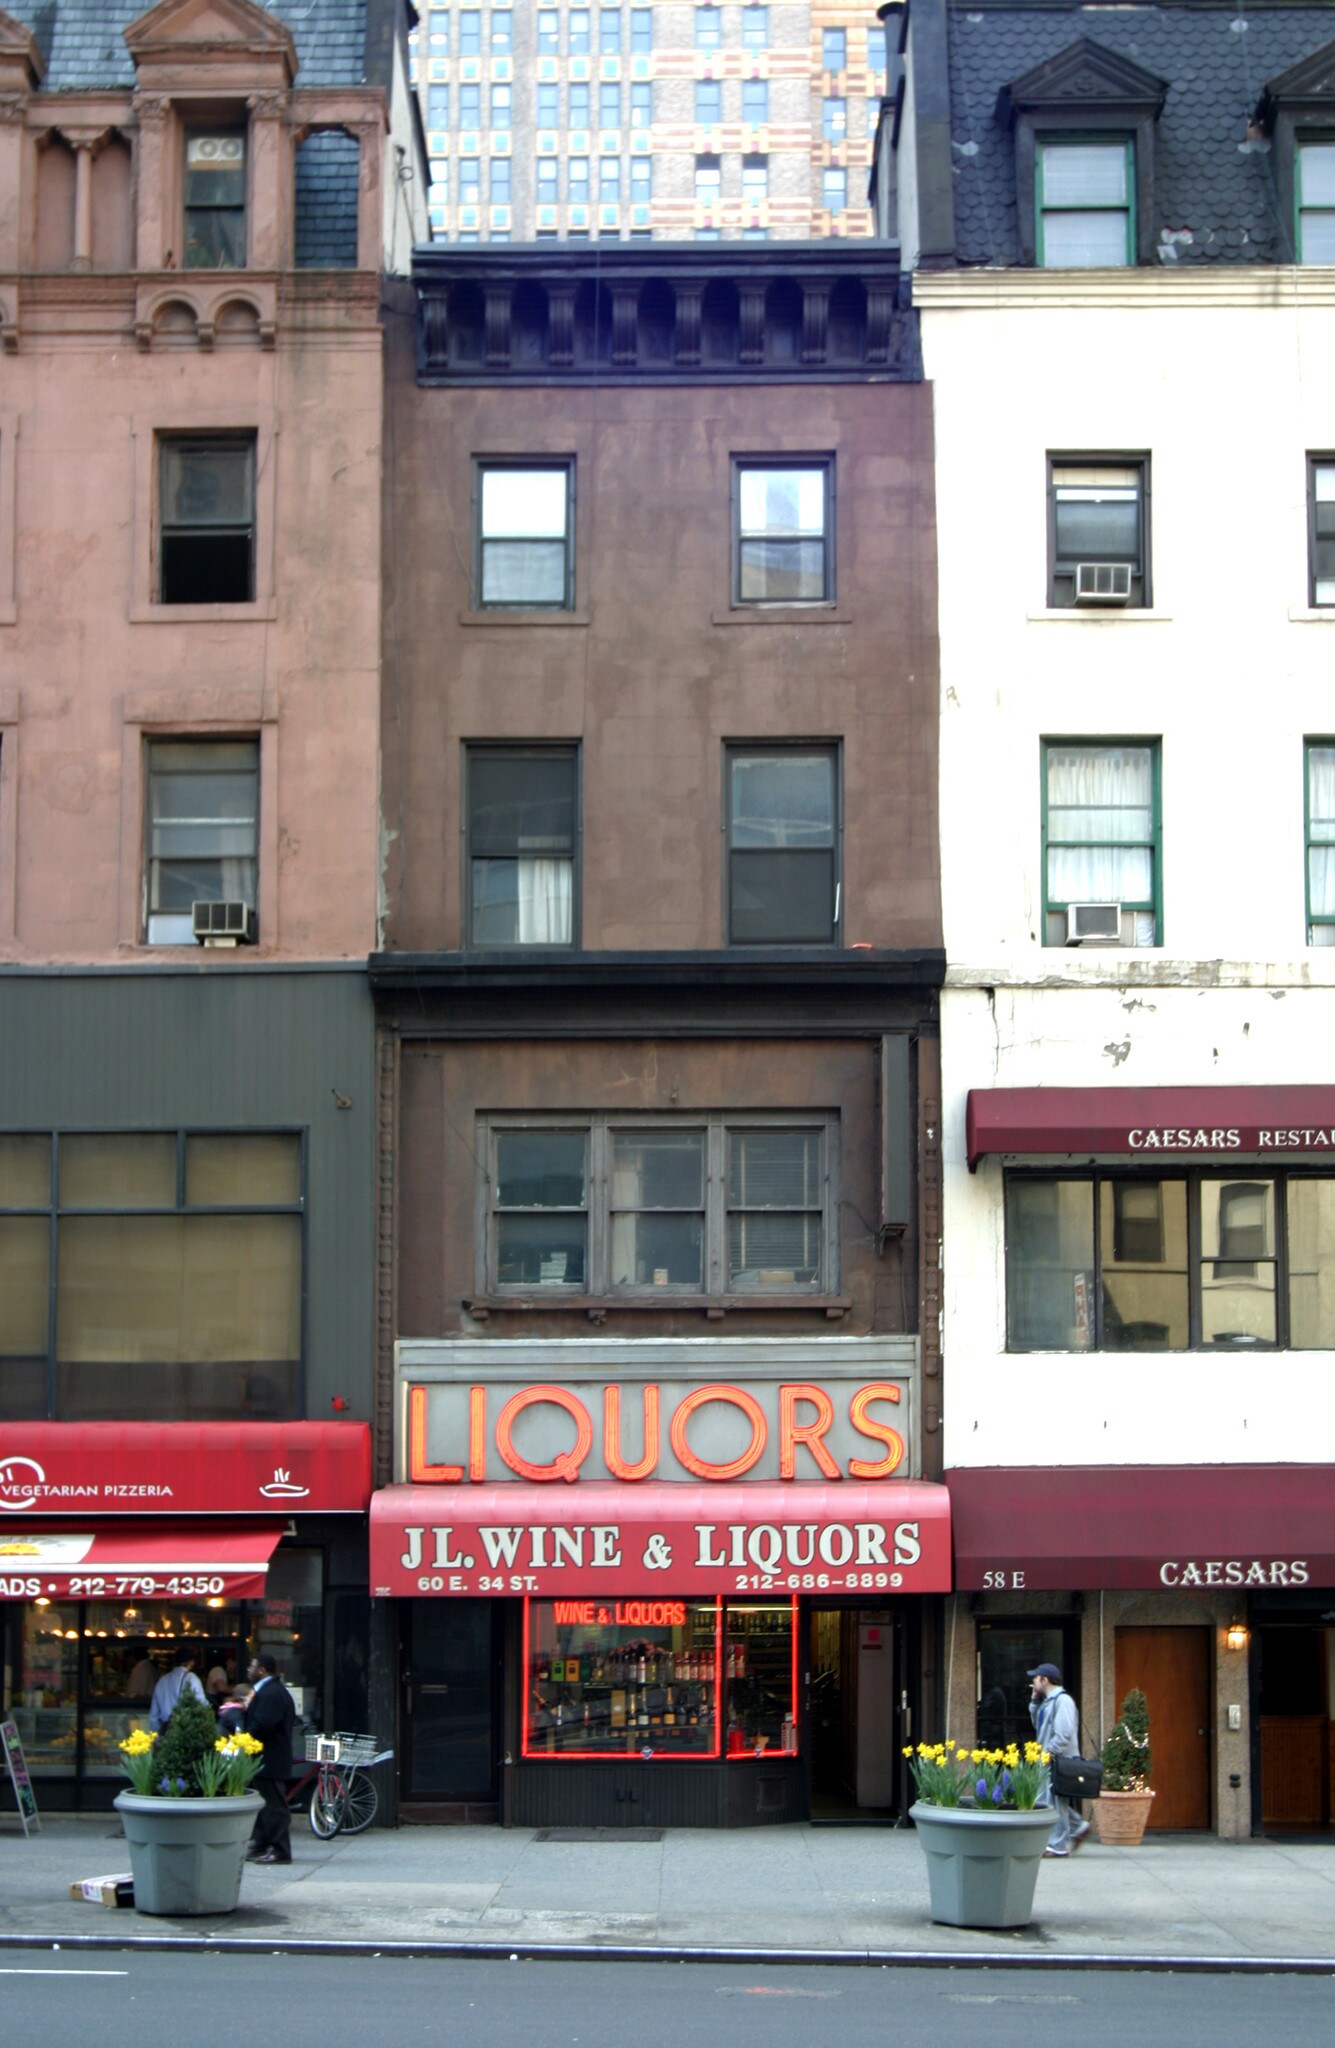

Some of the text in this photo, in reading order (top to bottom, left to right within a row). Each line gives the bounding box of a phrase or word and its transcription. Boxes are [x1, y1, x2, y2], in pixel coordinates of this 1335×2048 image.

[1128, 1129, 1241, 1148] CAESARS
[408, 1383, 904, 1483] LIQUORS
[2, 1484, 173, 1497] VEGETARIAN PIZZERIA
[642, 1533, 673, 1570] &
[694, 1522, 922, 1575] LIQUORS
[735, 1572, 904, 1590] 212-686-8899
[982, 1571, 1026, 1589] 58 E
[1159, 1560, 1310, 1586] CAESARS
[69, 1576, 225, 1596] 212-779-4350
[417, 1575, 539, 1592] 60 E. 34 ST.
[553, 1600, 687, 1626] WINE & LIQUORS
